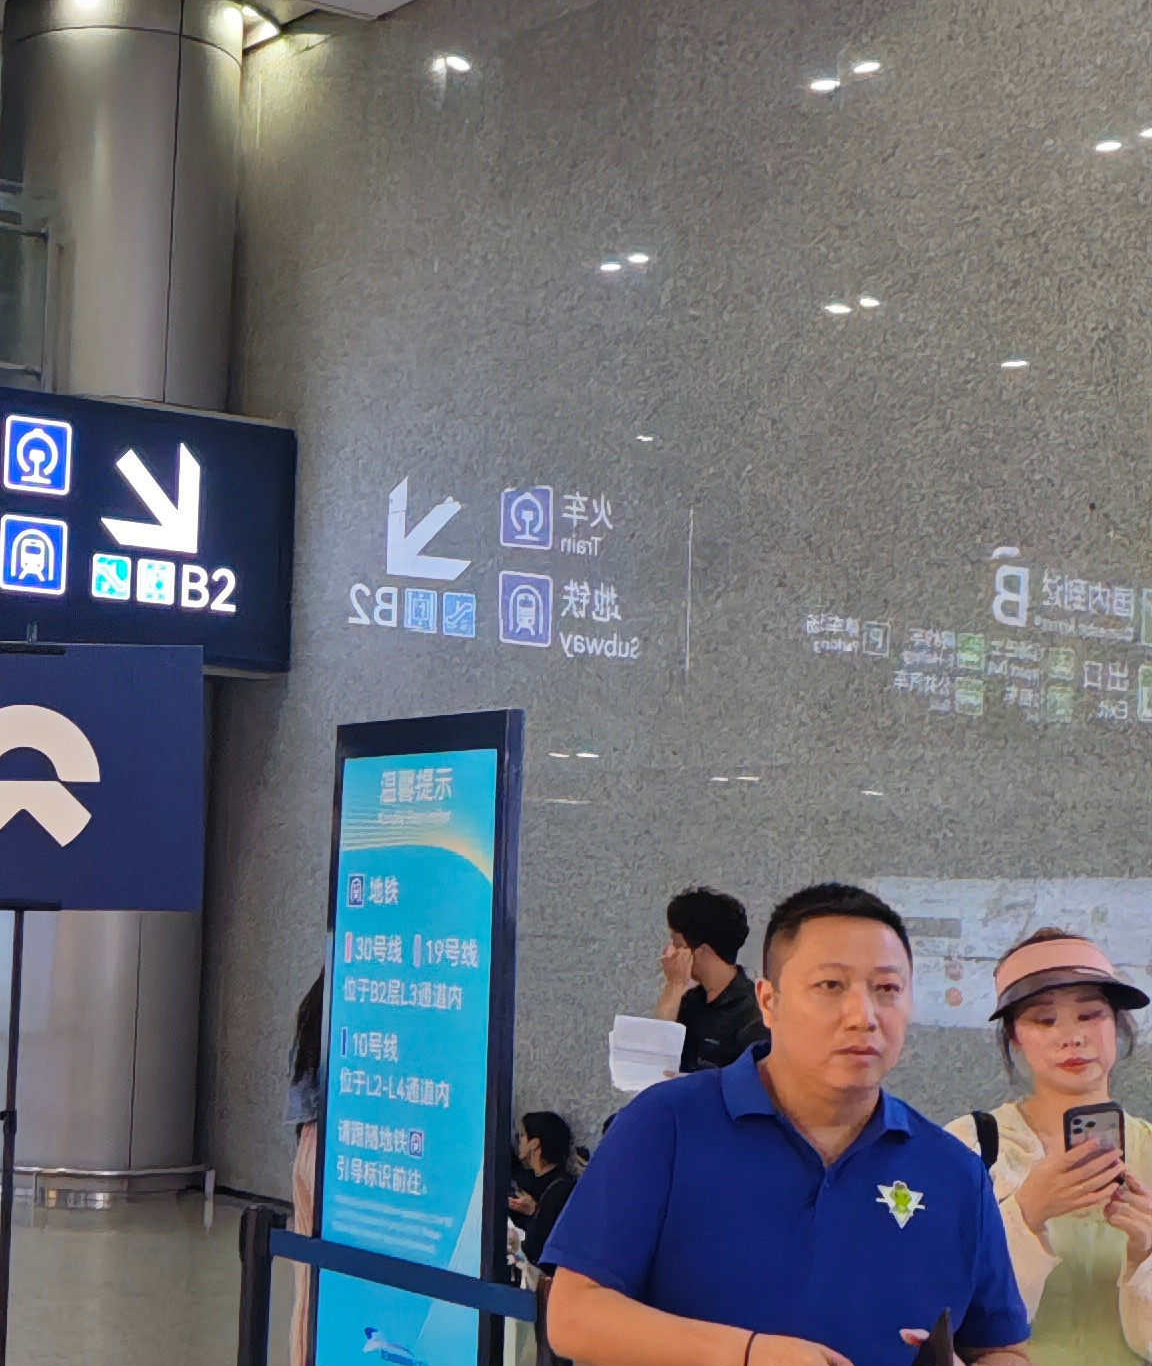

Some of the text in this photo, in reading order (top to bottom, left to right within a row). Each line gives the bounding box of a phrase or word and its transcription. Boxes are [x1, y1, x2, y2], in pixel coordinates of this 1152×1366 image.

[180, 568, 237, 613] B2
[369, 875, 399, 905] 地铁
[354, 934, 403, 964] 30号线
[426, 938, 479, 968] 19号线
[352, 1032, 399, 1063] 10号线
